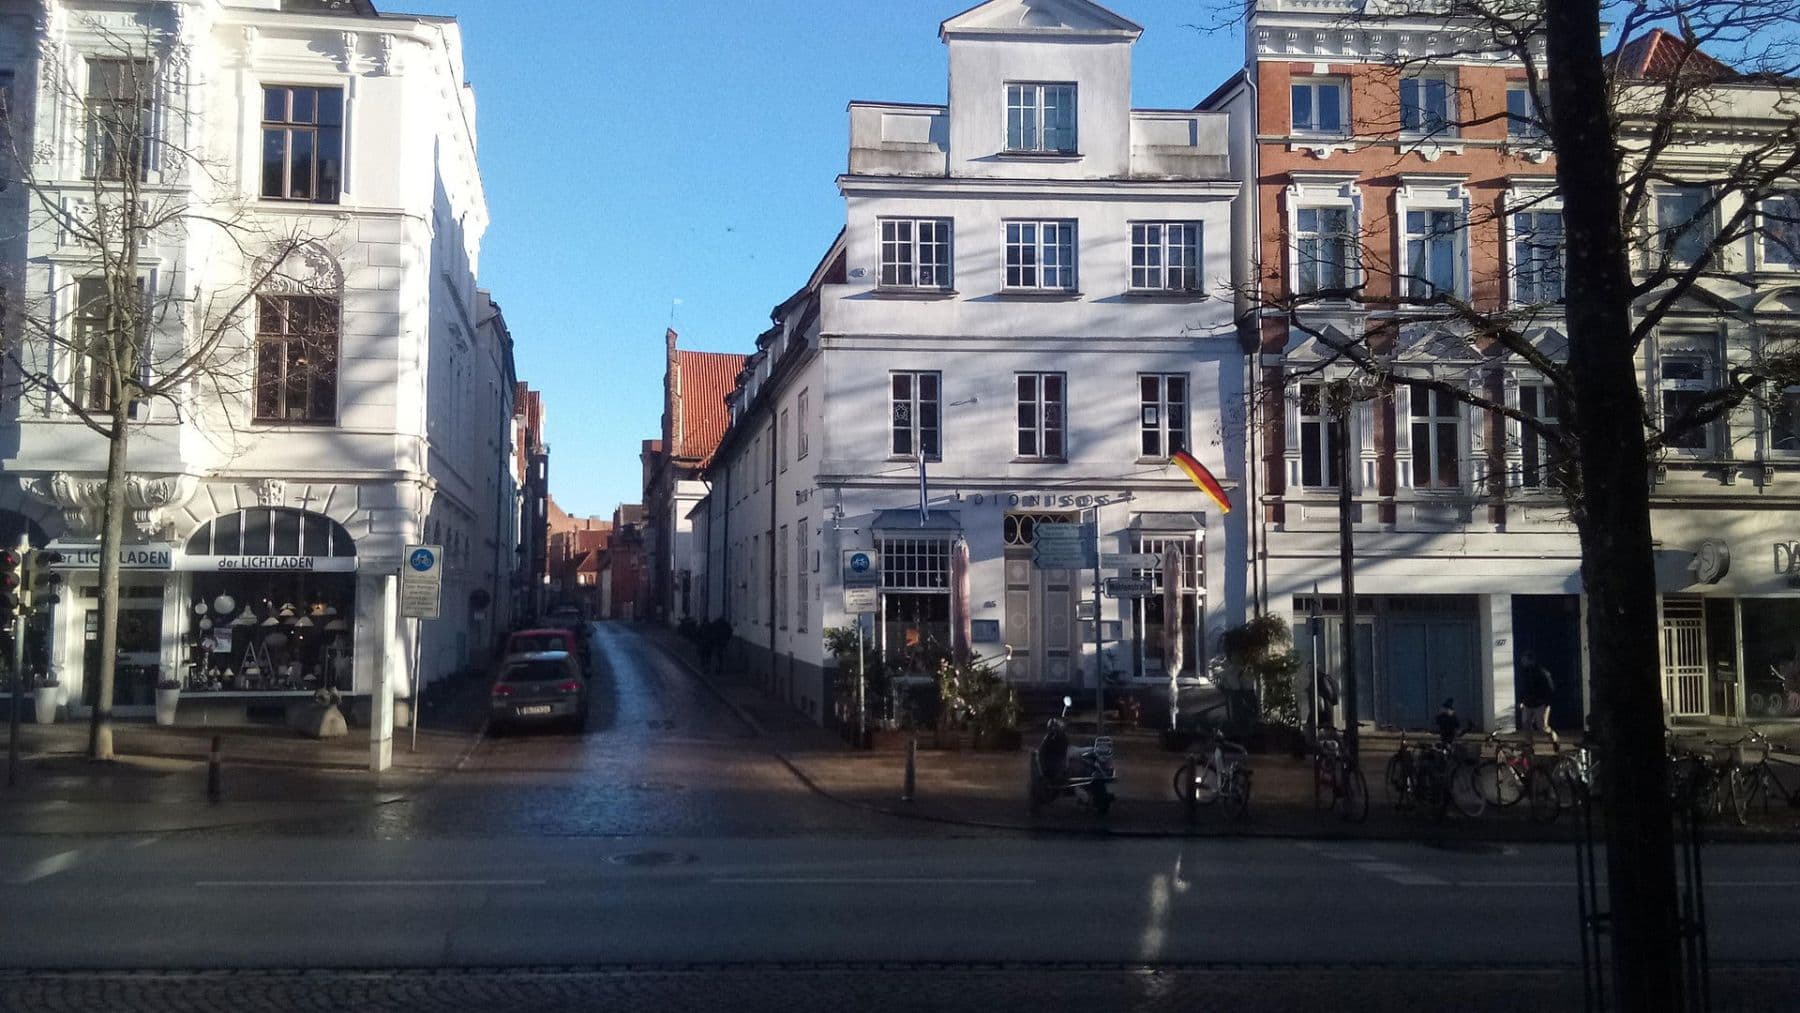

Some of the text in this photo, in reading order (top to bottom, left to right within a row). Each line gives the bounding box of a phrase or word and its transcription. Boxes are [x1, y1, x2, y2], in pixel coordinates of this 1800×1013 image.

[77, 551, 169, 564] LICLADEN
[218, 556, 314, 568] der LICHTLADEN
